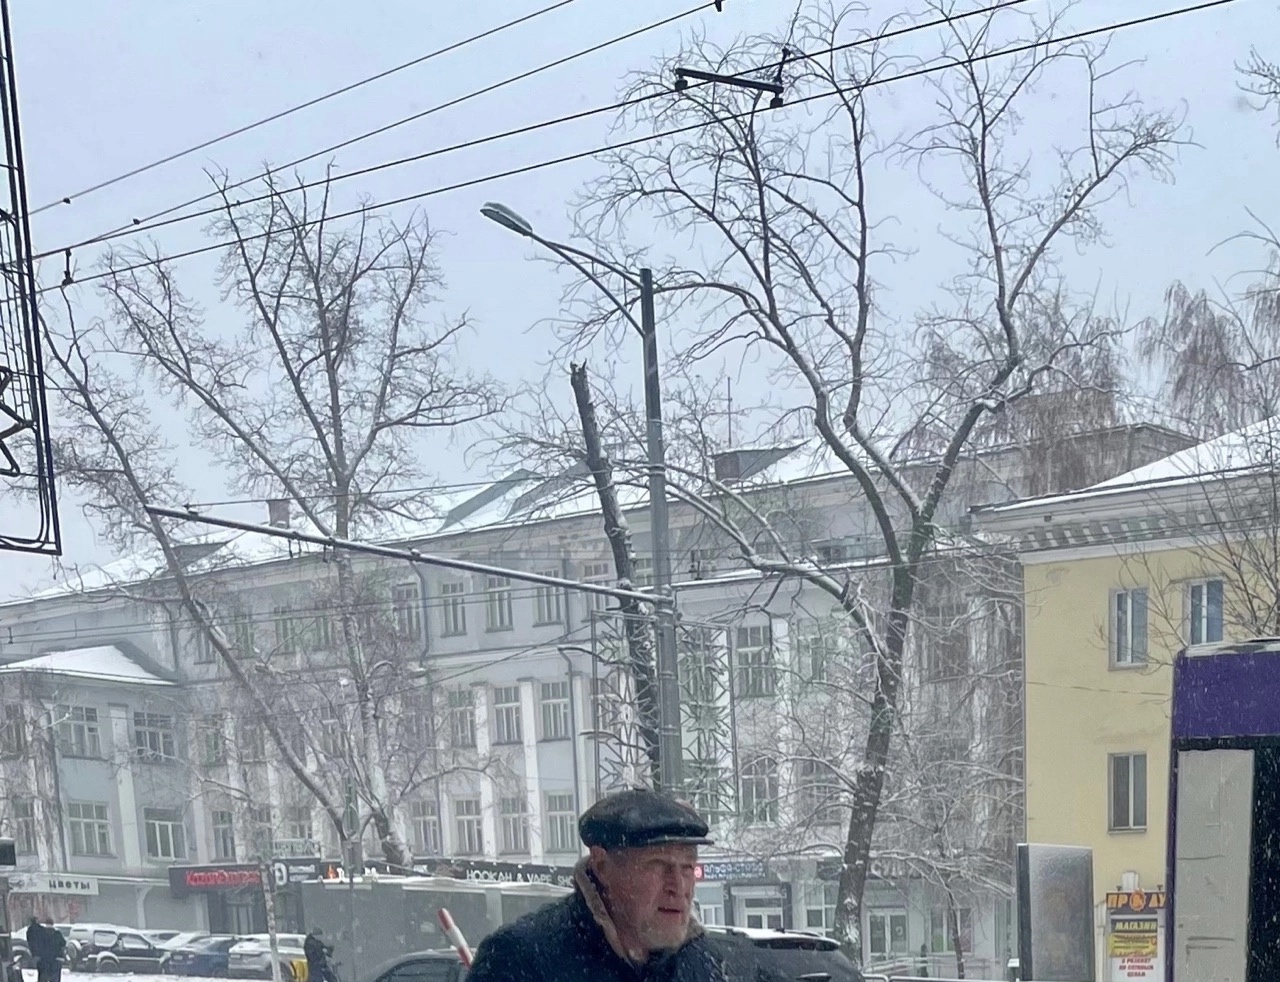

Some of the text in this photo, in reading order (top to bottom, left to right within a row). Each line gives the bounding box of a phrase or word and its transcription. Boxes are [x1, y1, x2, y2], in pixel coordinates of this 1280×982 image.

[466, 869, 513, 882] HOOKAH
[527, 873, 553, 884] VAPE
[1114, 920, 1158, 931] МАГАЗИН
